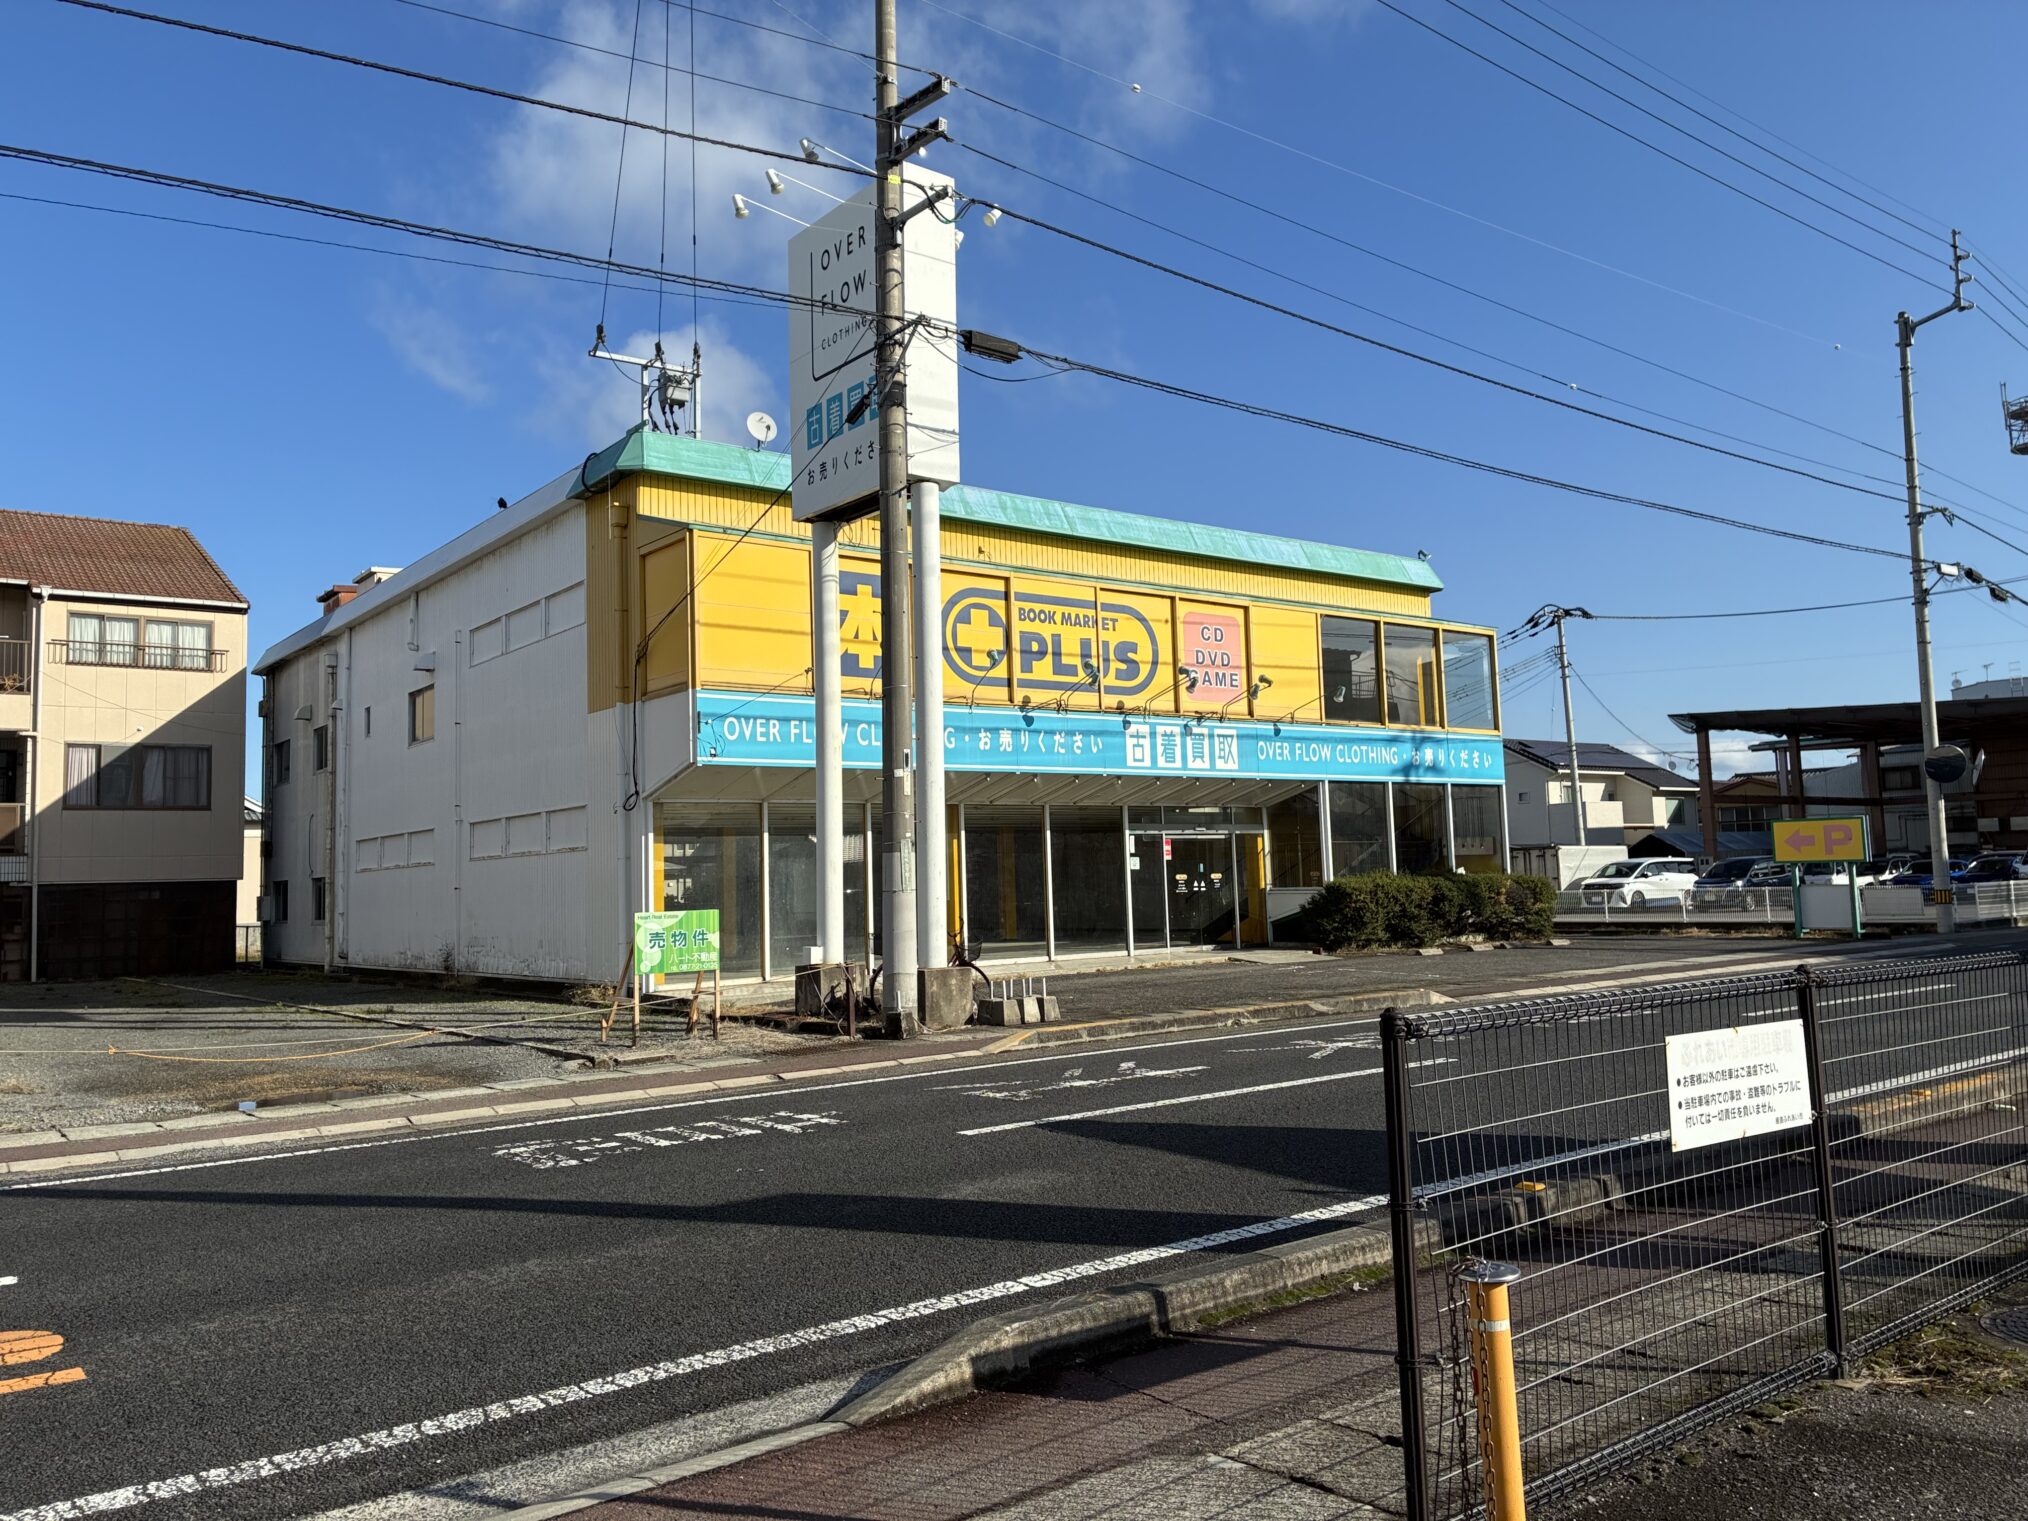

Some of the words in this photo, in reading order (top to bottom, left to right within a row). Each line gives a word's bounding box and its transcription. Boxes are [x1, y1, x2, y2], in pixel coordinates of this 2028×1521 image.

[820, 225, 867, 271] OVER
[820, 268, 867, 316] FLOW
[820, 316, 868, 351] CLOTHING
[807, 439, 876, 487] お売りくださ
[1018, 606, 1057, 625] BOOK
[1060, 611, 1119, 632] MARKET
[1200, 625, 1225, 643] CD
[1018, 630, 1142, 683] PLUS
[1194, 649, 1232, 668] DVD
[723, 716, 782, 743] OVER
[978, 727, 1103, 755] お売りください
[1128, 728, 1237, 766] 古着買取
[1257, 740, 1291, 761] OVER
[1295, 742, 1332, 763] FLOW
[1336, 744, 1398, 765] CLOTHING
[1411, 747, 1493, 769] お売りください
[1823, 824, 1854, 856] P
[648, 929, 709, 949] 売物件
